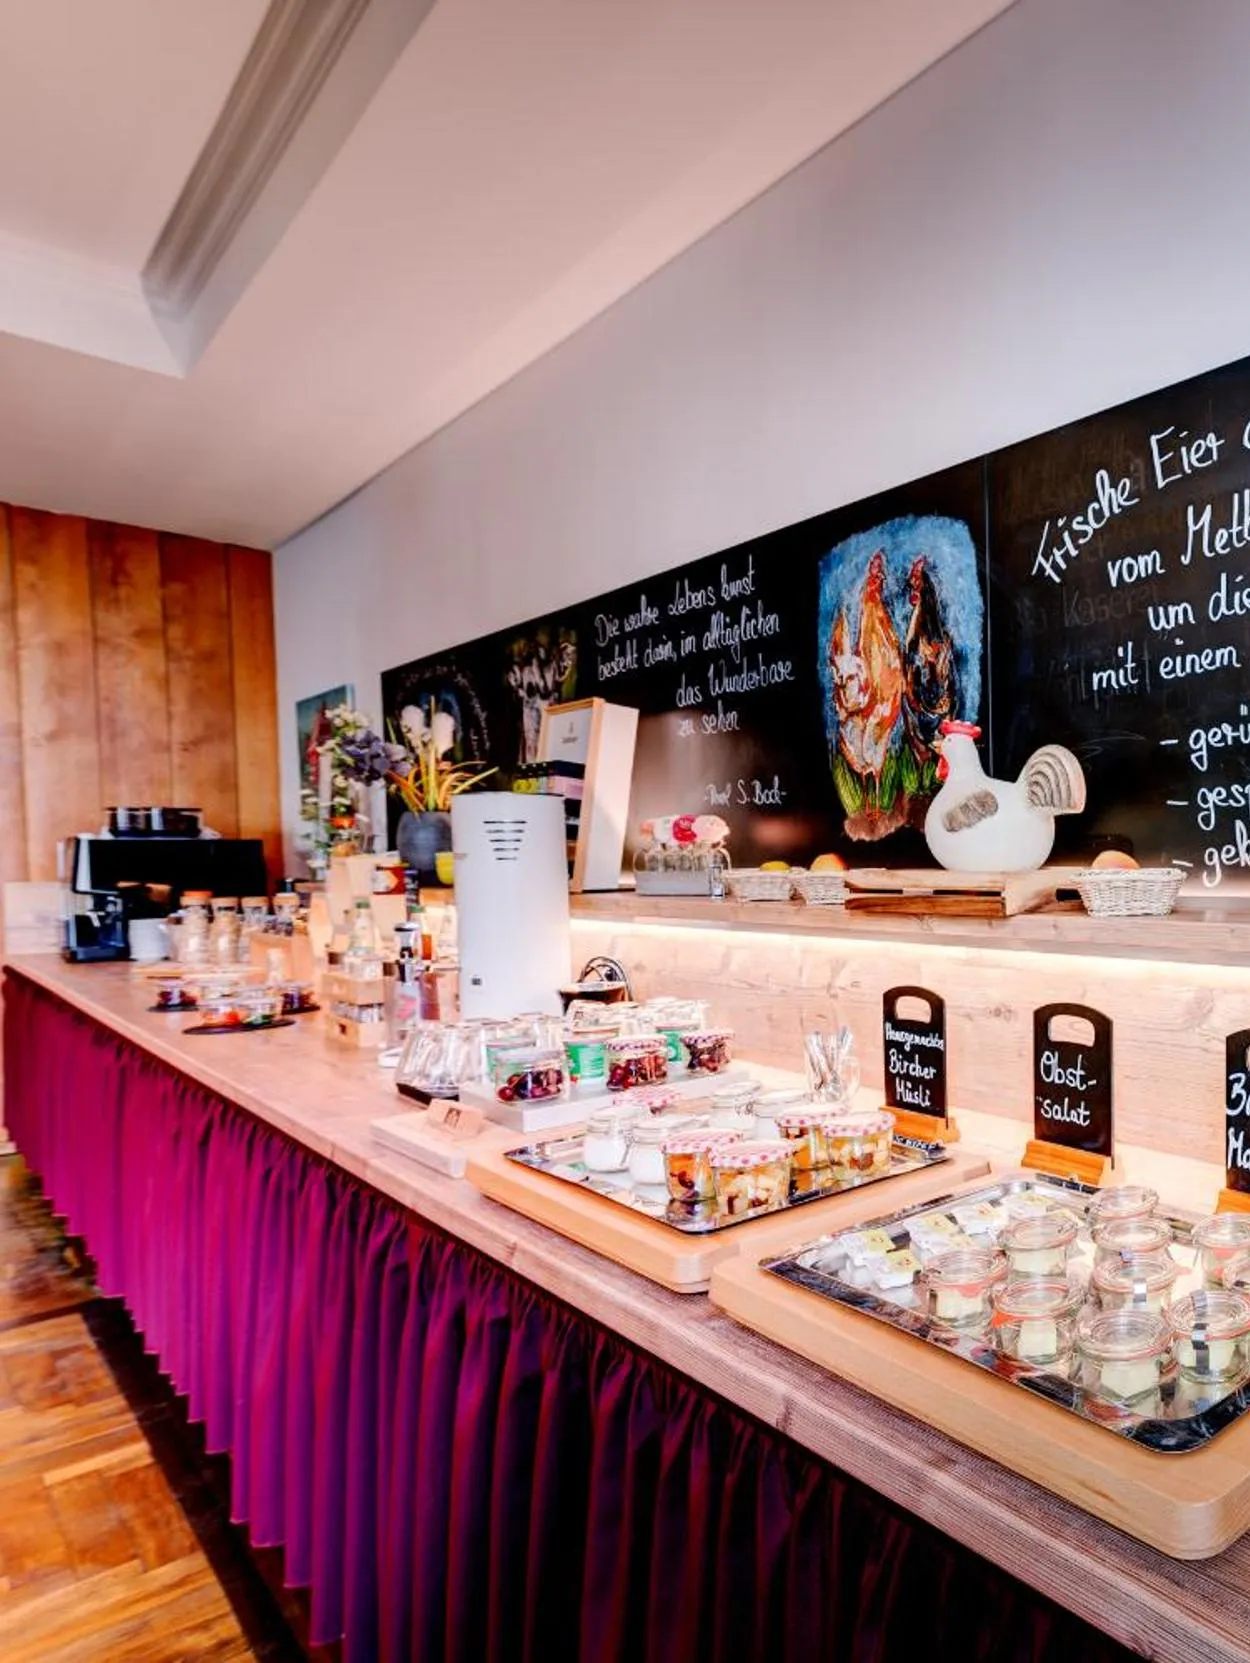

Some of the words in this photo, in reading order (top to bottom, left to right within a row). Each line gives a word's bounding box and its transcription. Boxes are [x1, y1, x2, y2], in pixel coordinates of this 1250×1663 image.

[1031, 469, 1139, 583] Frische
[1150, 426, 1225, 489] Eier
[1107, 550, 1166, 588] vom
[594, 614, 620, 647] Die
[1148, 602, 1195, 631] um
[598, 638, 638, 681] besteht
[680, 630, 696, 657] im
[1092, 641, 1139, 691] mit
[1159, 638, 1241, 679] einem
[676, 673, 702, 708] das
[708, 653, 795, 697] Wunderbare
[678, 719, 695, 737] zu
[702, 700, 740, 735] sehen
[889, 1048, 937, 1079] Bircher
[1040, 1051, 1097, 1090] Obst-
